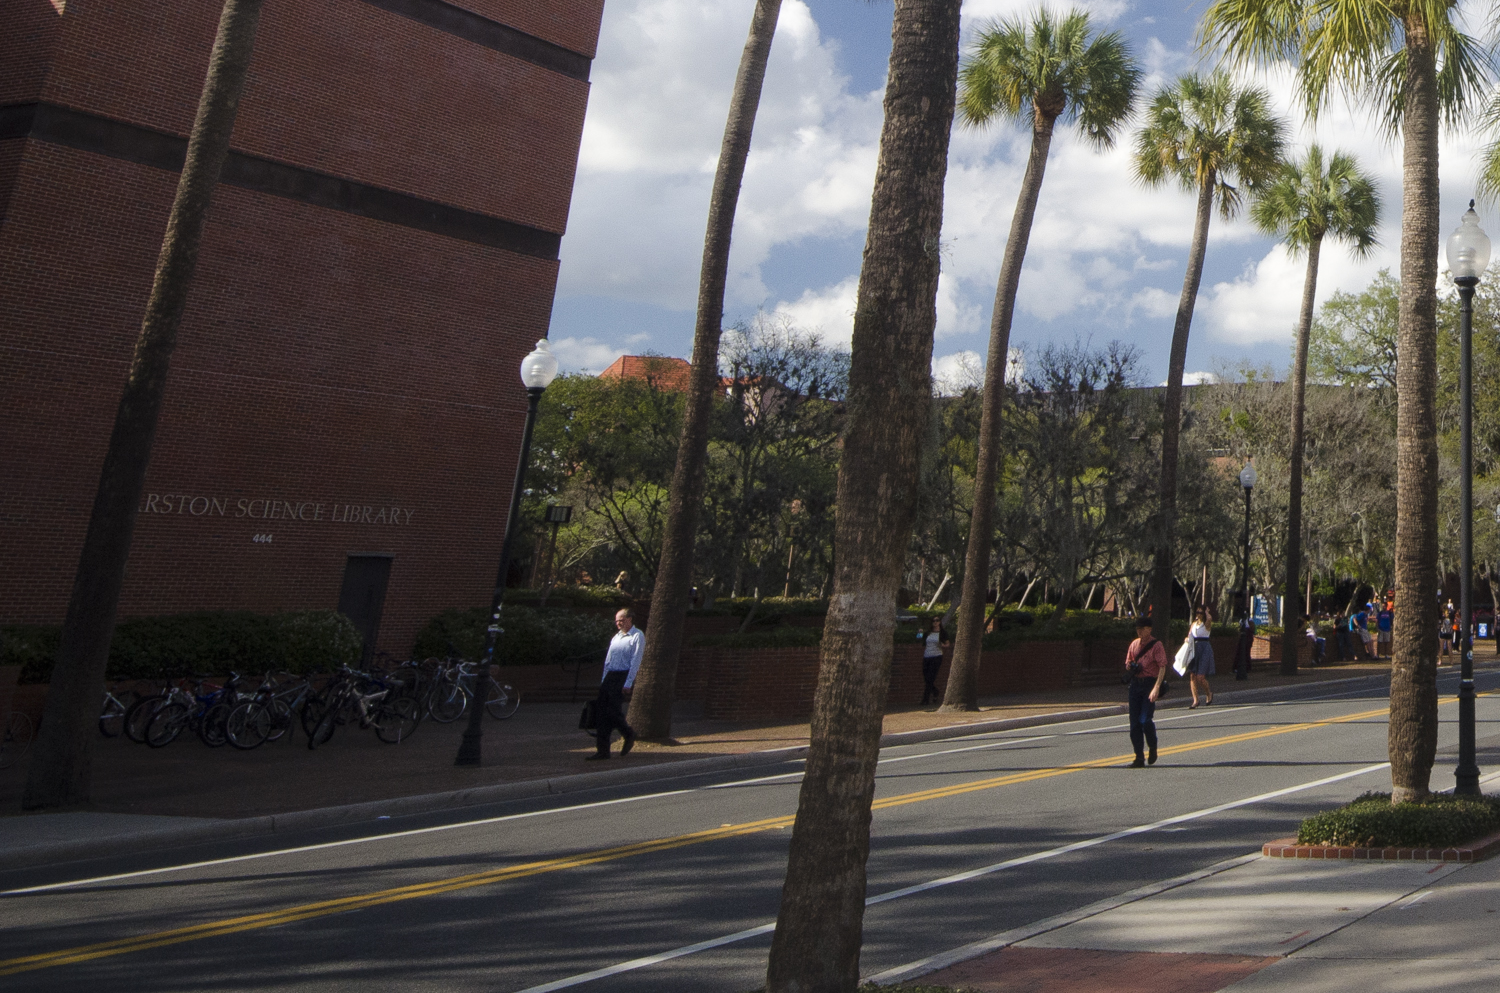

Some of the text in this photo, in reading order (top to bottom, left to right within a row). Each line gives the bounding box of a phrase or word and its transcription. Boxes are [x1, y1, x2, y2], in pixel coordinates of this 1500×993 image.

[137, 493, 416, 526] RSTON SCIENCE LIBRARY
[252, 533, 273, 544] 444
